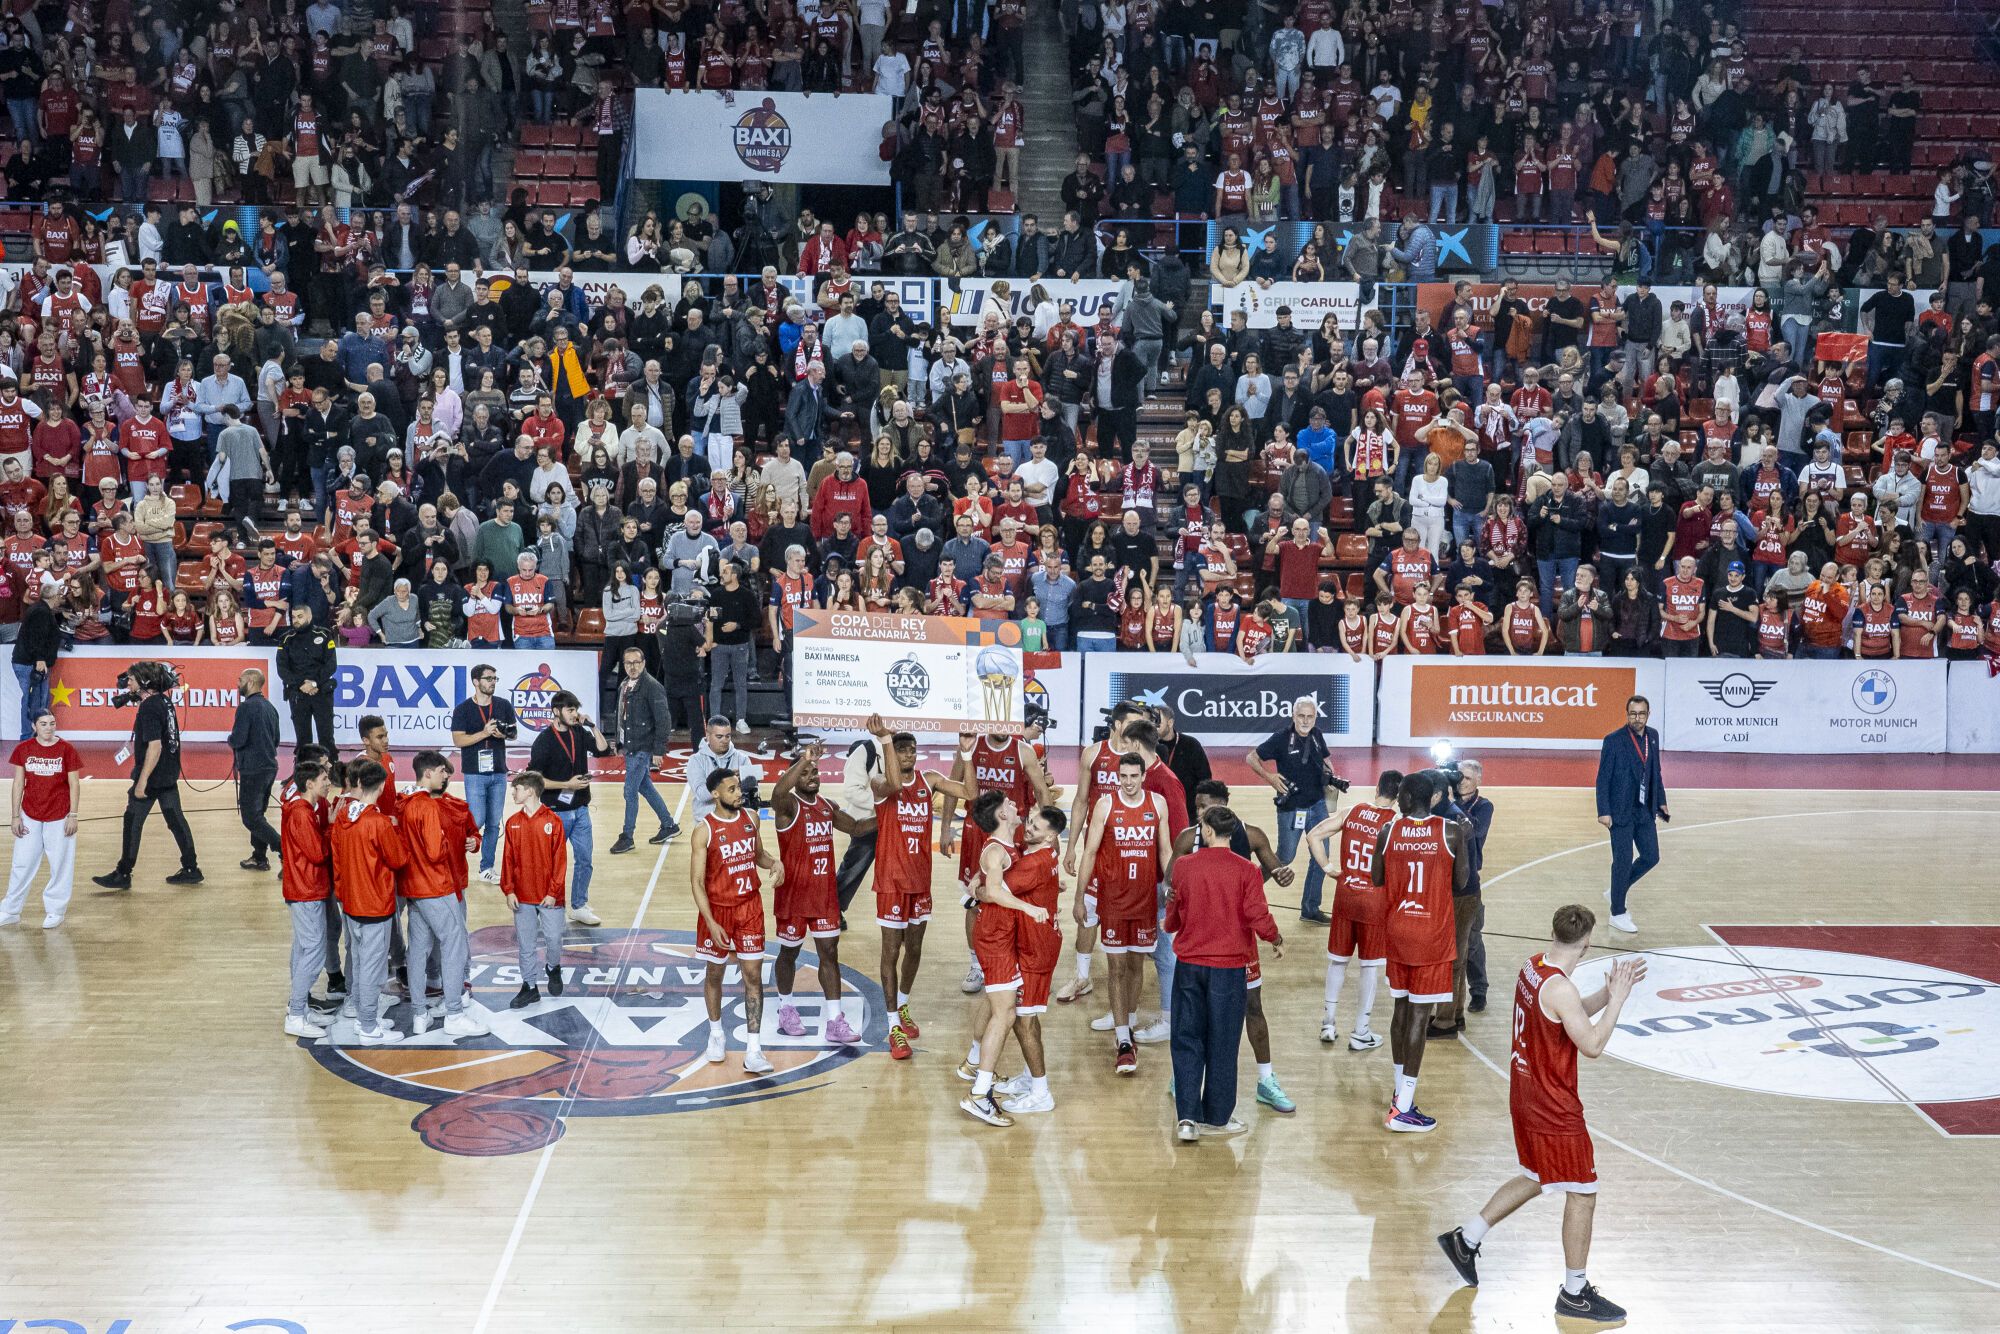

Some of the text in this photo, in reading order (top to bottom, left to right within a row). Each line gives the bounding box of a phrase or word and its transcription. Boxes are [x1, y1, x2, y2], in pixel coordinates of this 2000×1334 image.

[736, 127, 790, 146] BAXI
[745, 148, 781, 158] MANRESA
[1404, 404, 1427, 413] BAXI
[1397, 563, 1428, 572] BAXI
[515, 593, 542, 603] BAXI
[1672, 595, 1699, 604] BAXI
[831, 614, 926, 630] COPA DEL REY
[831, 627, 926, 641] GRAN CANARIA '25
[824, 654, 860, 662] MANRESA
[816, 670, 850, 678] MANRESA
[1859, 671, 1890, 685] BMW
[334, 664, 466, 708] BAXI
[837, 680, 868, 688] CANARIA
[888, 675, 929, 689] BAXI
[189, 688, 245, 706] DAM
[897, 689, 923, 698] MANRESA
[1449, 681, 1598, 707] mutuacat
[1725, 686, 1750, 695] MINI
[513, 691, 552, 706] BAX
[835, 698, 871, 707] 13-2-2025
[1177, 689, 1328, 717] CaixaBak
[333, 713, 452, 730] CLITIZACIÓ
[1449, 711, 1543, 723] ASSEGURANCES
[1695, 717, 1778, 727] MOTOR MUNICH
[1830, 718, 1917, 728] MOTOR MUNICH
[793, 716, 859, 728] CLASIFICADO
[959, 722, 1022, 734] CLASIFICADO
[1723, 732, 1749, 742] CADÍ
[1860, 733, 1887, 743] CADÍ
[976, 767, 1015, 783] BAXI
[1097, 771, 1120, 784] BA
[897, 801, 928, 817] BAXI
[1358, 809, 1381, 823] PÉREZ
[805, 820, 833, 838] BAXI
[901, 824, 924, 833] MANRESA
[1114, 826, 1154, 841] BAXI
[1346, 820, 1380, 836] inmoov
[1402, 826, 1431, 838] MASSA
[719, 837, 756, 860] BAXI
[809, 844, 830, 854] MANRES
[908, 838, 919, 854] 21
[1394, 841, 1438, 852] inmoovs
[1120, 850, 1148, 858] MANRESA
[1347, 840, 1374, 872] 55
[728, 862, 755, 875] MANRESA
[813, 858, 828, 876] 32
[1129, 863, 1137, 880] 8
[1408, 862, 1423, 893] 11
[736, 877, 753, 896] 24
